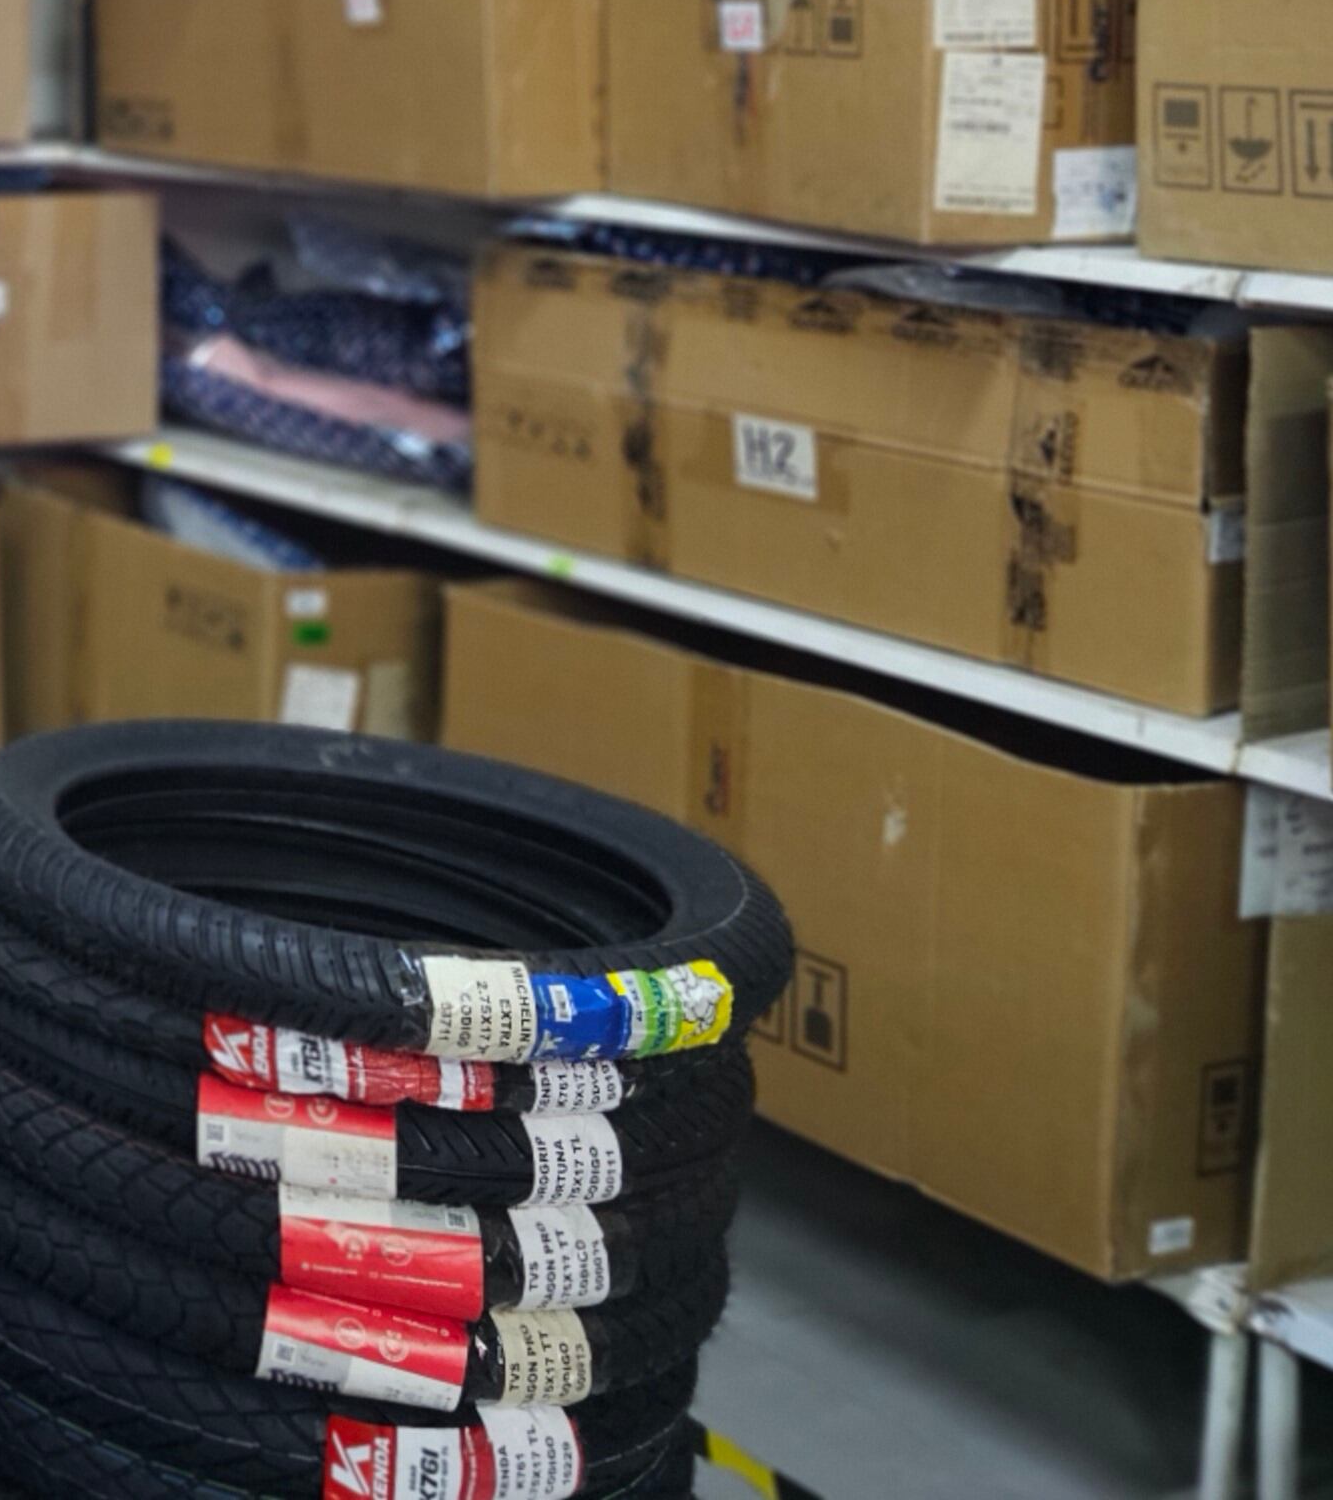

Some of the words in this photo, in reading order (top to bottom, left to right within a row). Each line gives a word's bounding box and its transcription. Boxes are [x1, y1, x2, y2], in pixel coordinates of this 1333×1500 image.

[741, 424, 798, 474] H2
[457, 991, 472, 1049] CODIGO
[476, 980, 493, 1041] 2.75X17
[498, 998, 512, 1049] EXTRA
[510, 966, 532, 1042] MICHELIN
[583, 1145, 600, 1202] CODIGO
[535, 1220, 554, 1255] PRO
[528, 1261, 539, 1292] TVS
[537, 1330, 552, 1352] TT
[508, 1362, 520, 1392] TVS
[497, 1445, 510, 1499] KENDA
[515, 1453, 526, 1490] K761
